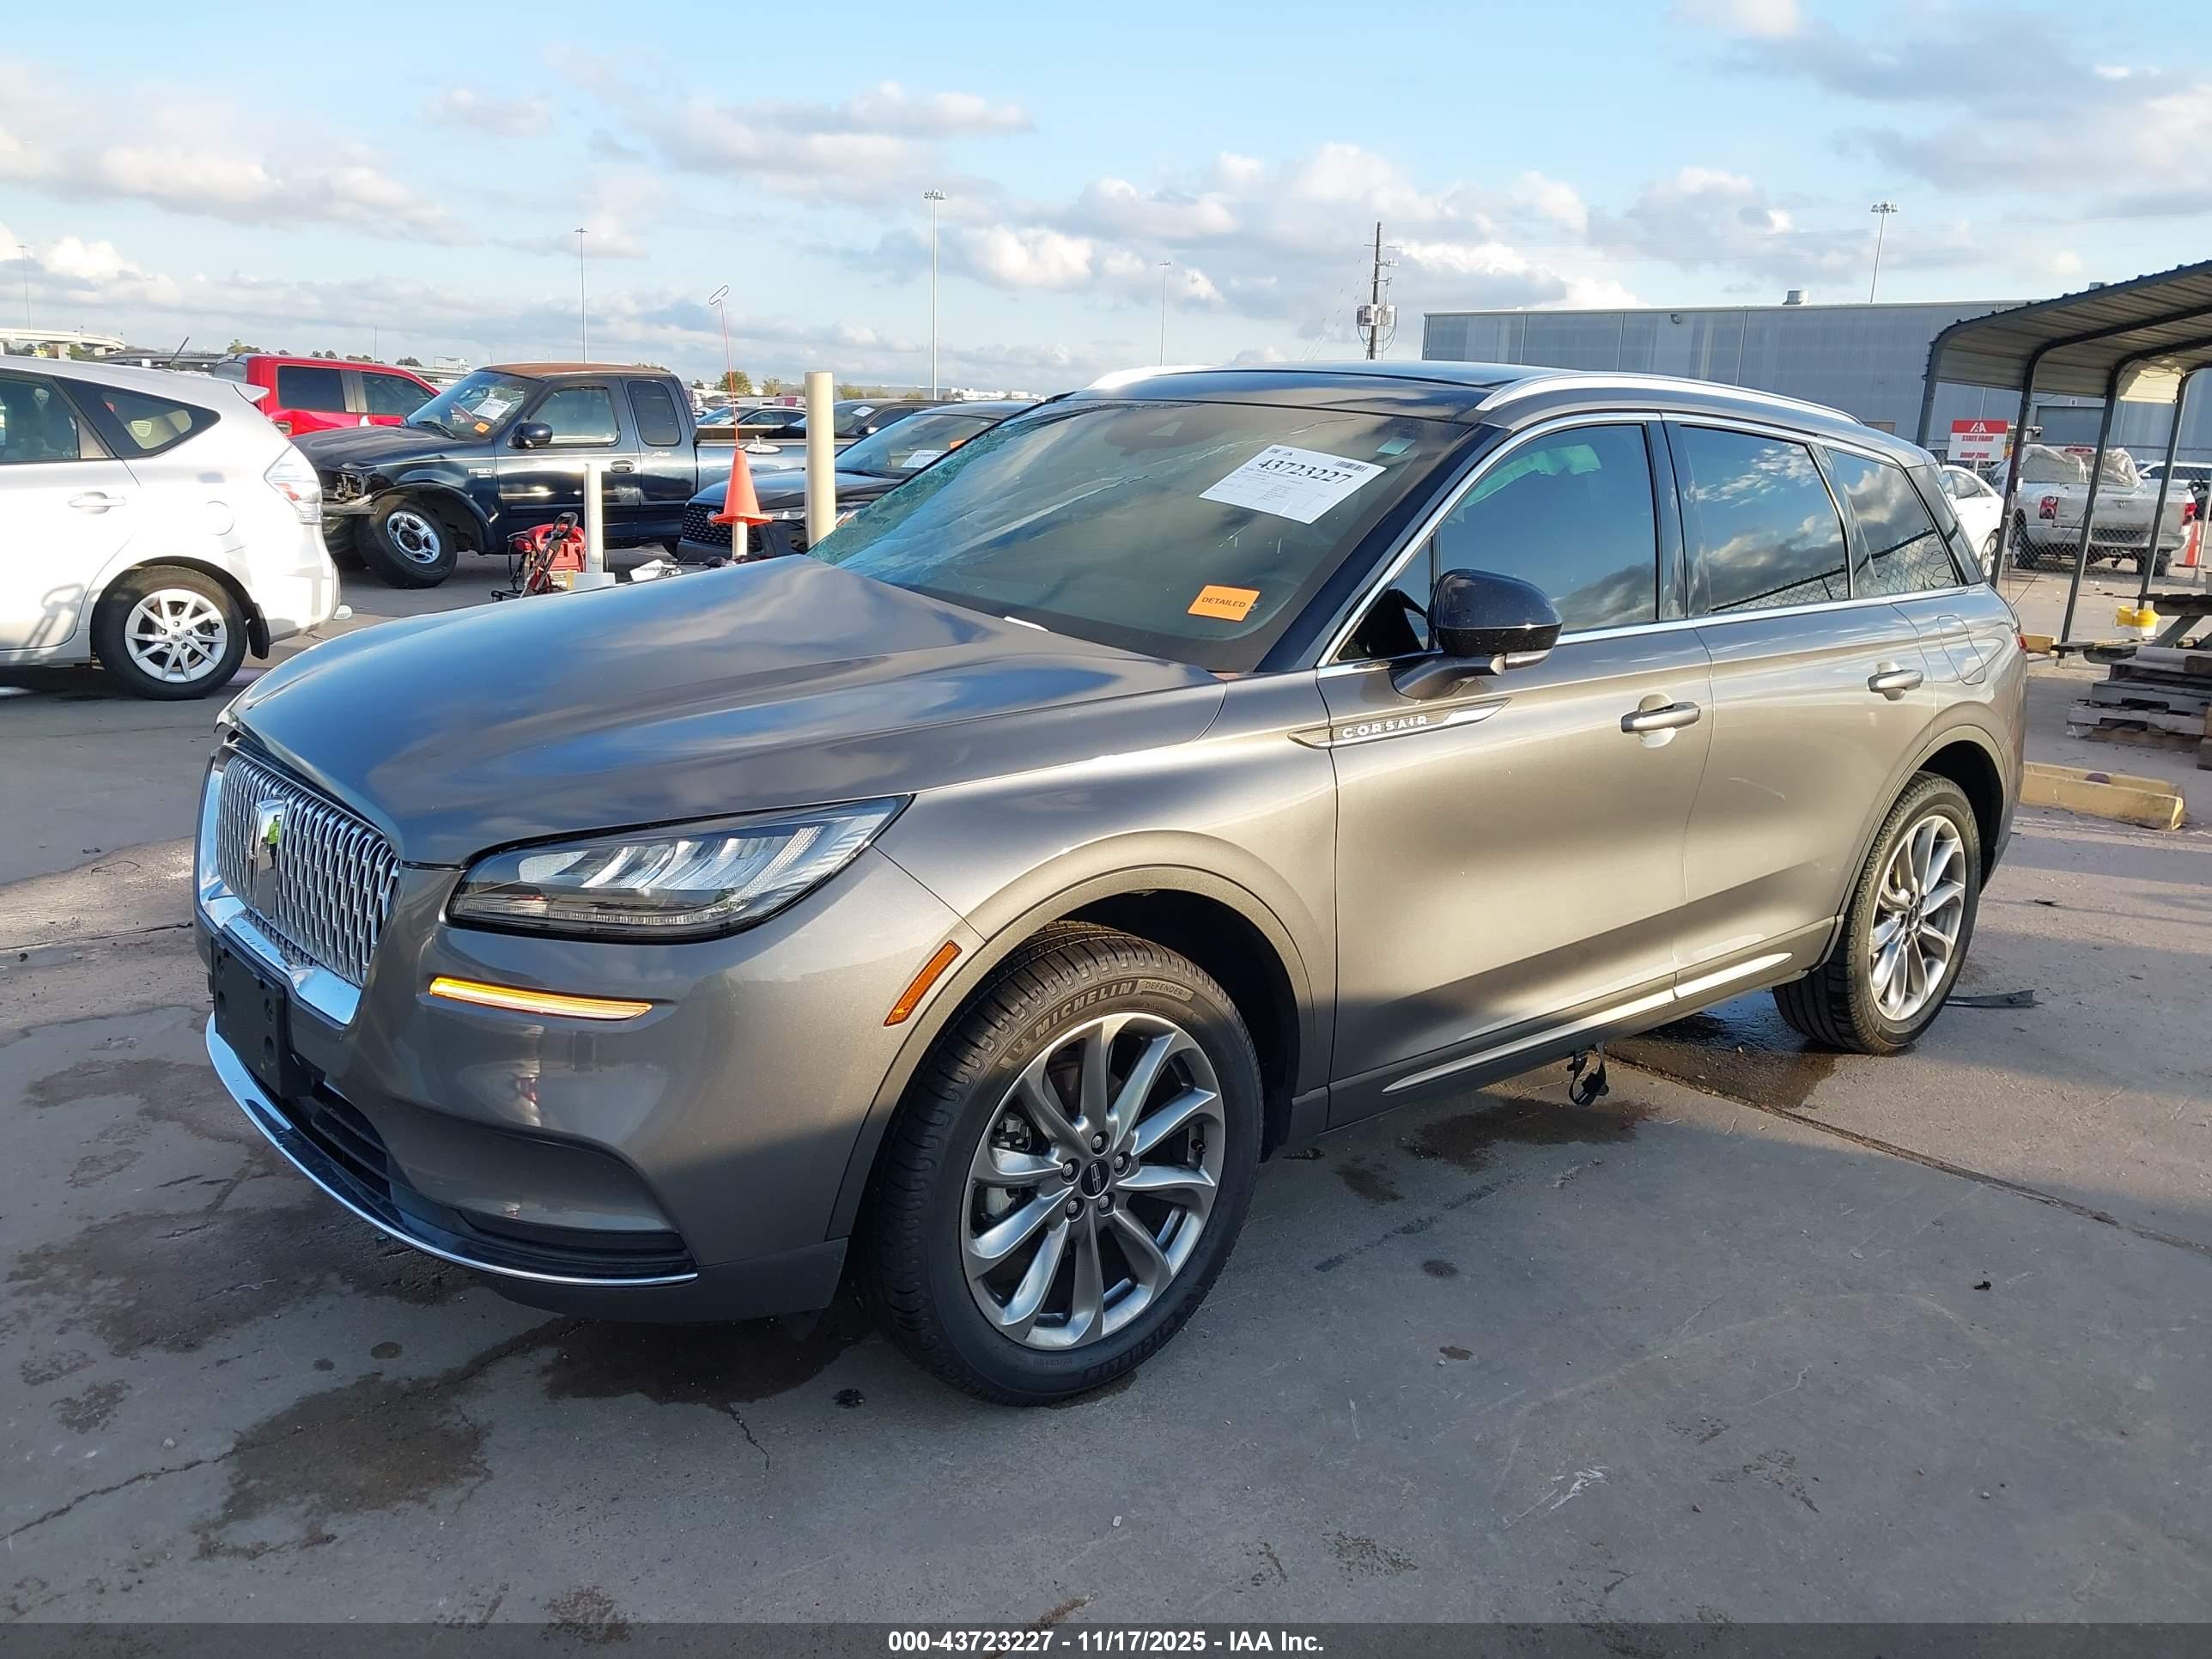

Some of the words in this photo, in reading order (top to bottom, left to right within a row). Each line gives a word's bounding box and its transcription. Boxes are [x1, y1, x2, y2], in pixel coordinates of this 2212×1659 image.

[1257, 458, 1354, 485] 43723227
[1201, 597, 1246, 608] DETAILED
[1341, 714, 1428, 739] CORSAIR
[1034, 981, 1133, 1039] MICHELIN
